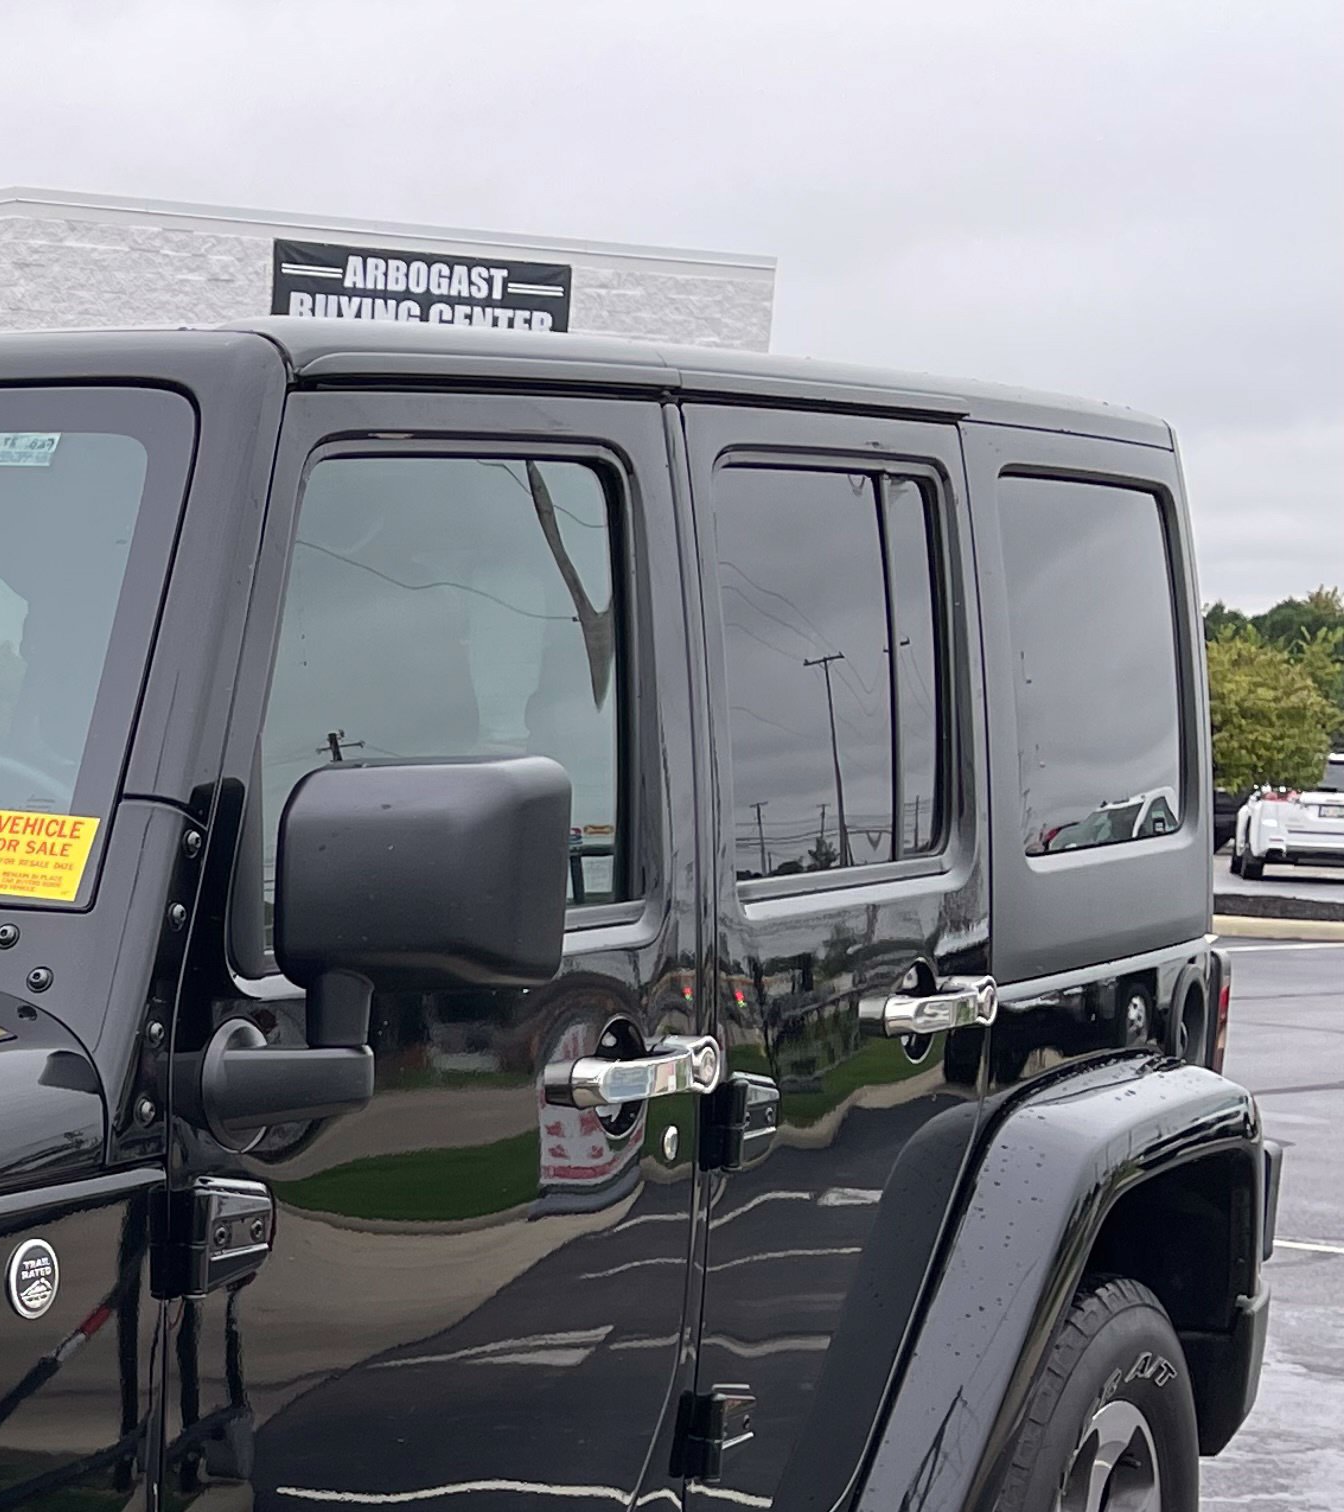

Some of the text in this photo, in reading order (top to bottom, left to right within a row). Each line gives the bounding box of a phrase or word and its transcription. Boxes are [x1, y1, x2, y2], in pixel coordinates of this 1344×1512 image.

[343, 255, 509, 300] ARBOGAST
[26, 841, 72, 856] SALE
[22, 1257, 51, 1270] TRAIL
[21, 1266, 52, 1280] RATED
